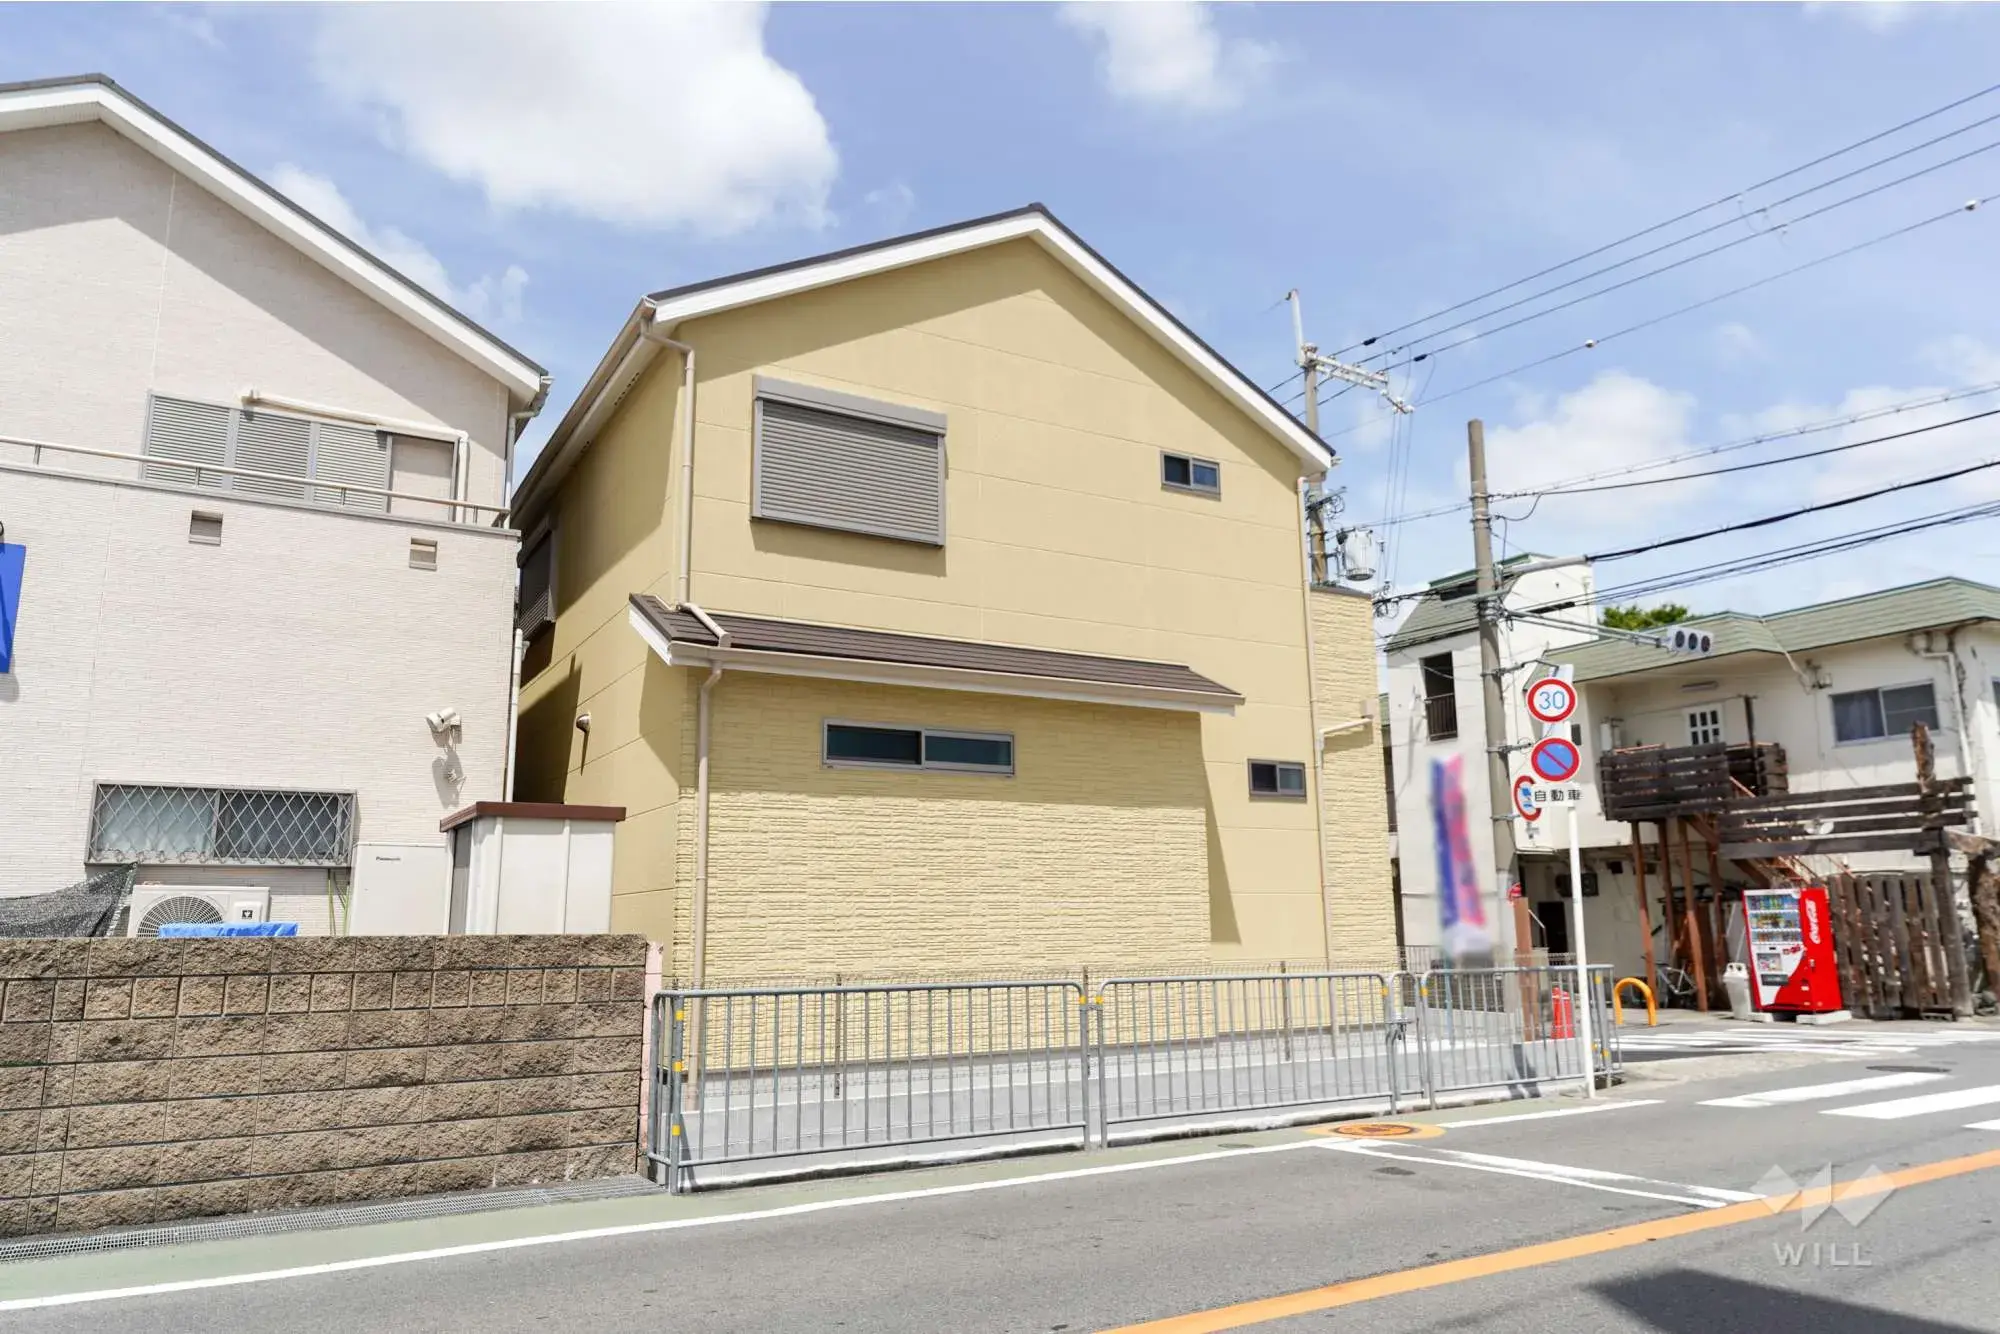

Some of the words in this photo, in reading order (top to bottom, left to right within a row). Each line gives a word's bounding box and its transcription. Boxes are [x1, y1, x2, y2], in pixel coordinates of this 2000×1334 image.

[1539, 690, 1565, 710] 30
[1534, 789, 1582, 802] 自動車
